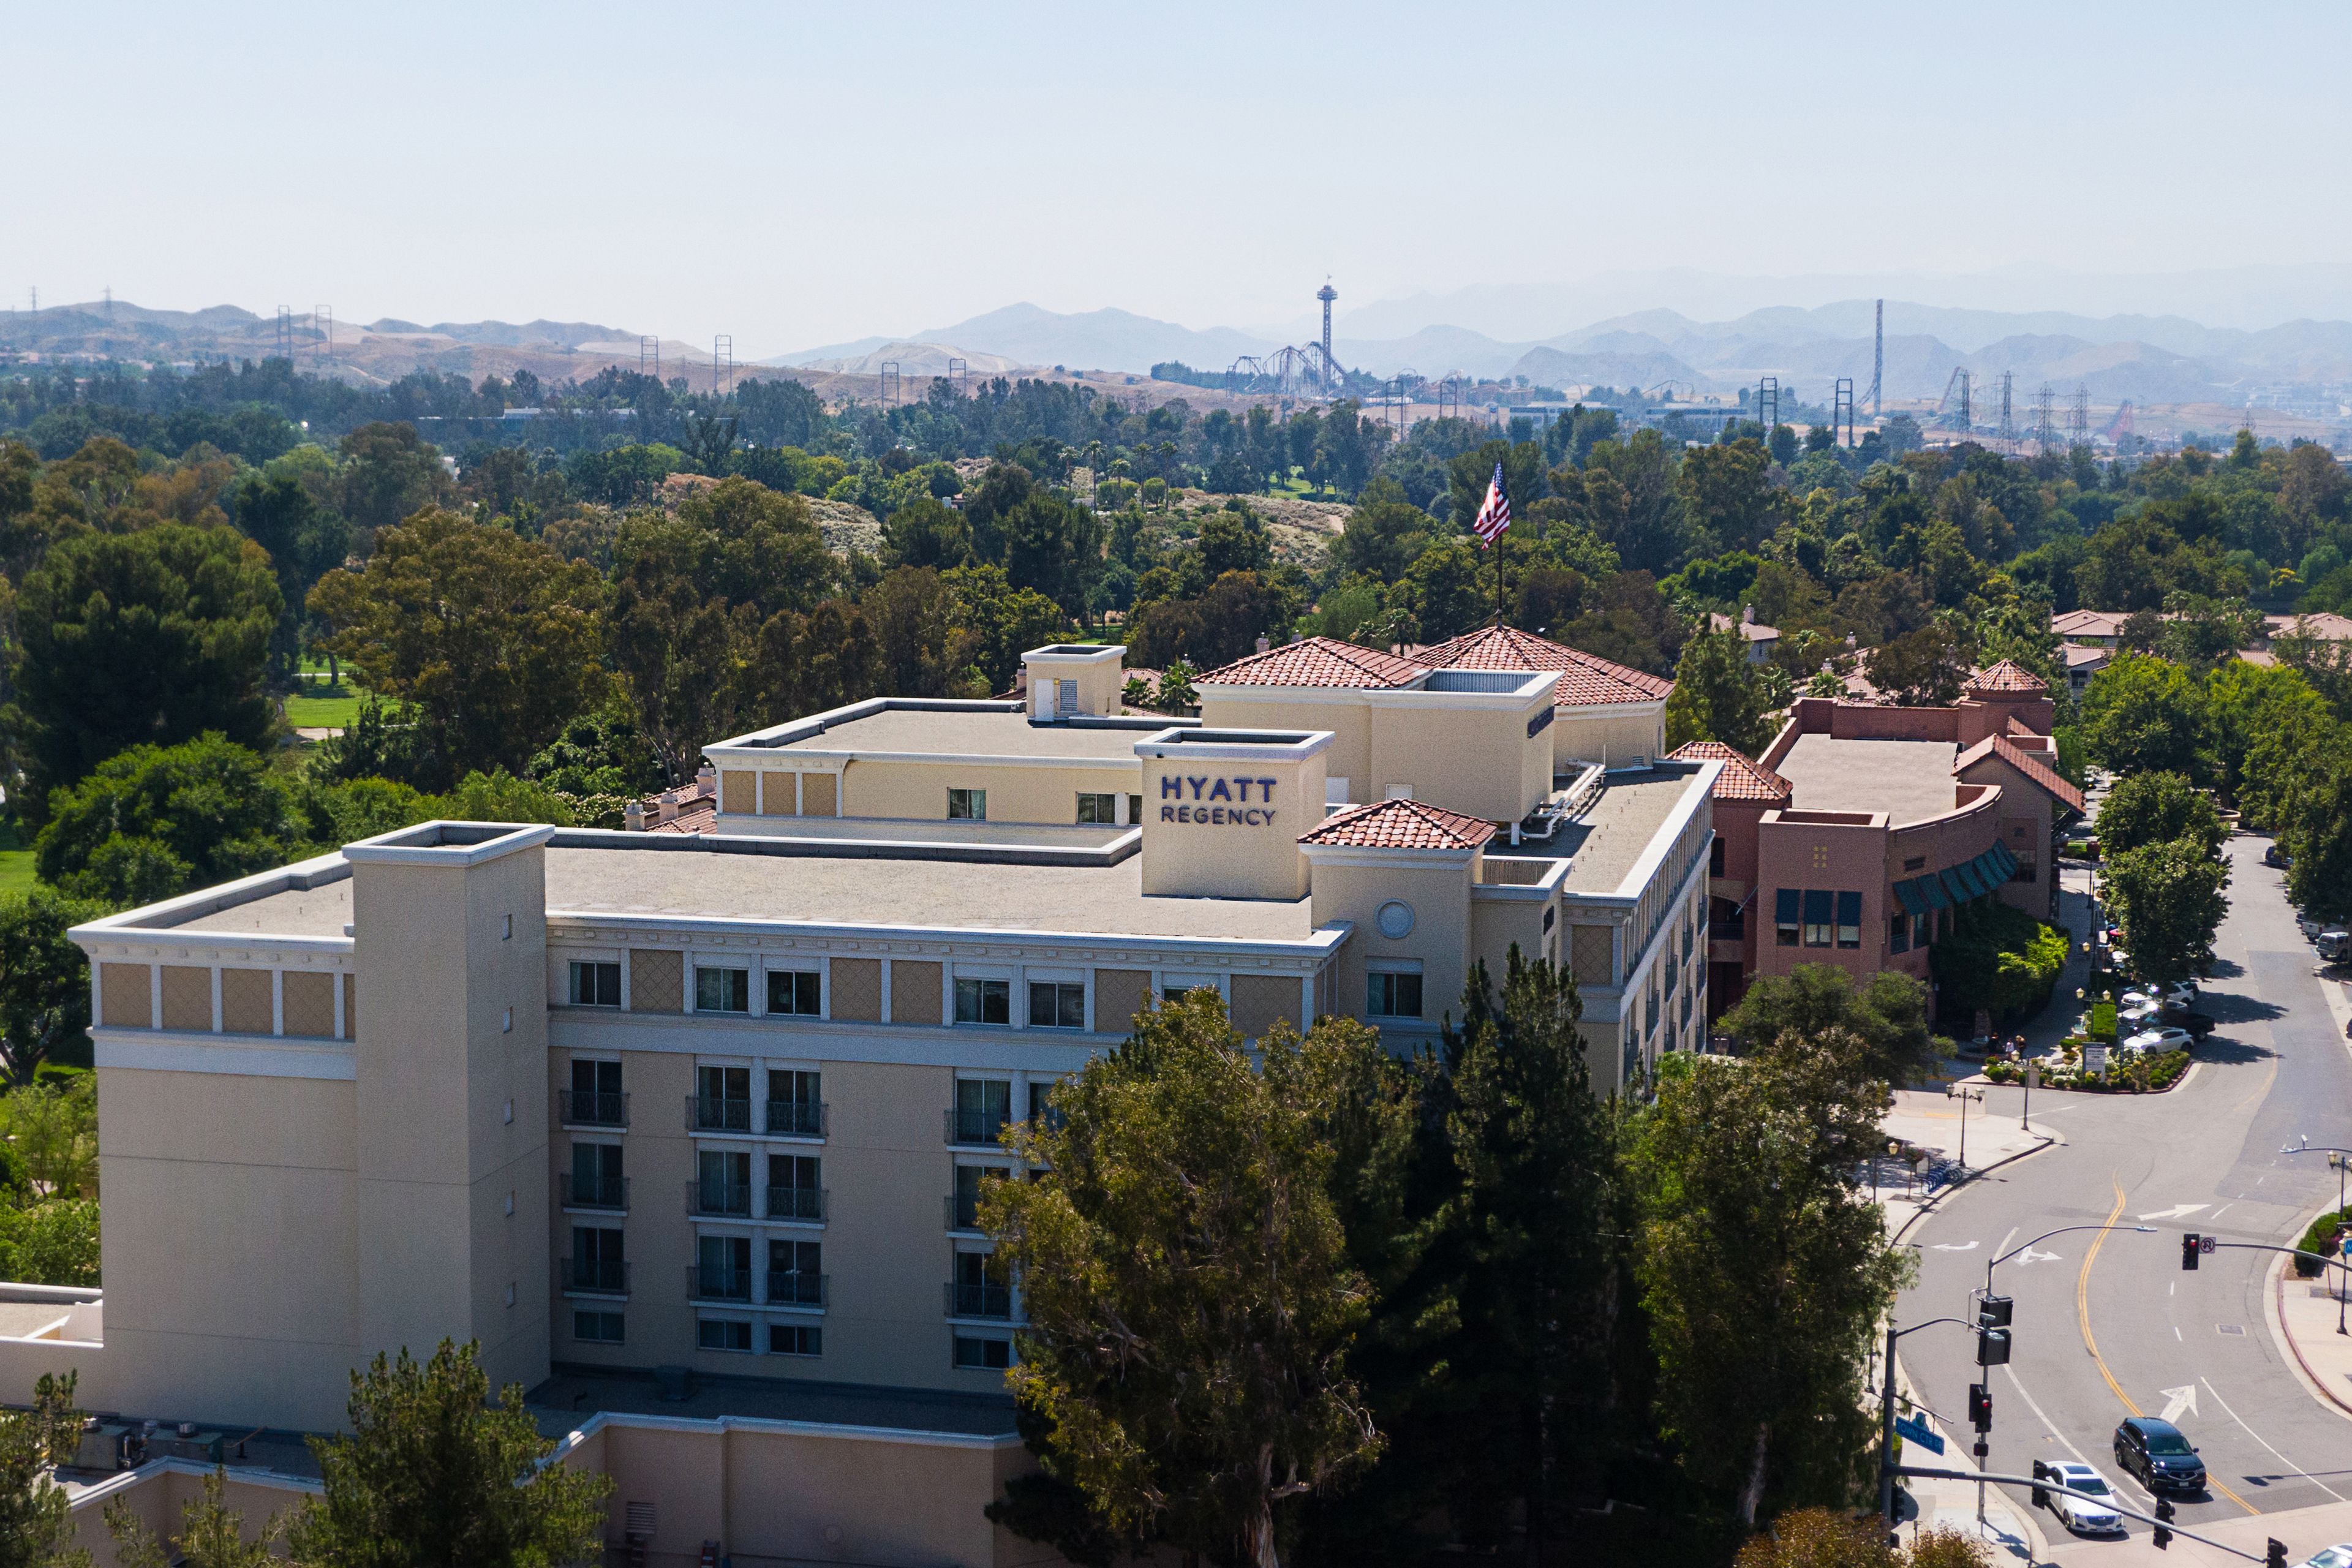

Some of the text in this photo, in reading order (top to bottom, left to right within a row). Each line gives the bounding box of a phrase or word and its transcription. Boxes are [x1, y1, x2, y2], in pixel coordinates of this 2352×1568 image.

[1161, 775, 1276, 802] HYATT
[1161, 805, 1276, 826] REGENCY
[1897, 1421, 1918, 1438] TOWN
[1920, 1433, 1933, 1446] CTR
